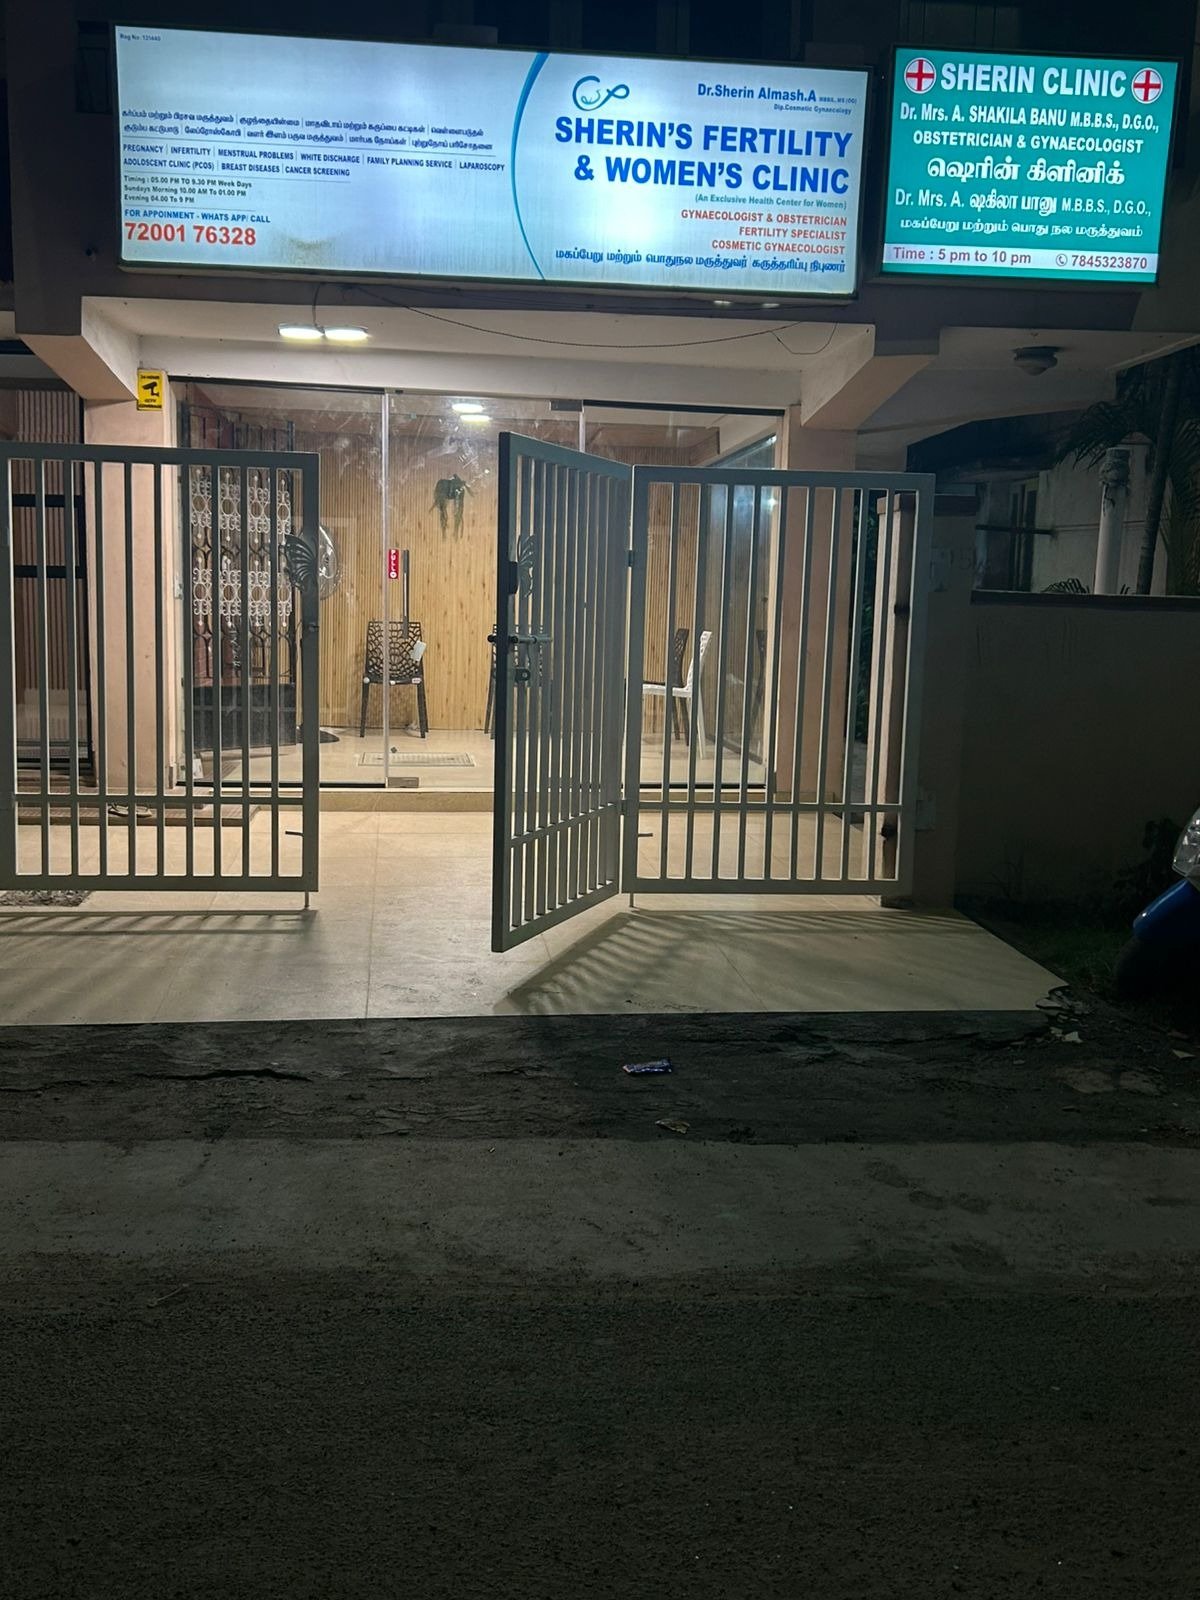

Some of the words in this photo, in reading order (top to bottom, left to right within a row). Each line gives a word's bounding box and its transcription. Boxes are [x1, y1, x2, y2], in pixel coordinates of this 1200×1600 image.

[941, 62, 1034, 94] SHERIN
[1043, 67, 1126, 98] CLINIC
[698, 84, 754, 98] Dr.Sherin
[758, 87, 816, 102] Almash.A
[900, 102, 916, 120] Dr.
[922, 103, 948, 121] Mrs.
[952, 105, 964, 122] A.
[970, 106, 1026, 125] SHAKILA
[1030, 108, 1066, 126] BANU
[1070, 112, 1118, 131] M.B.B.S.,
[1122, 114, 1159, 133] D.G.O.,
[555, 117, 692, 149] SHERIN'S
[703, 126, 852, 157] FERTILITY
[914, 130, 1012, 147] OBSTETRICIAN
[1016, 135, 1026, 148] &
[1031, 137, 1143, 153] GYNAECOLOGIST
[123, 144, 163, 153] PREGNANCY
[171, 146, 211, 156] INFERTILITY
[218, 149, 257, 158] MENSTRUAL
[259, 151, 294, 160] PROBLEMS
[301, 153, 321, 161] WHITE
[323, 154, 360, 163] DISCHARGE
[367, 156, 389, 165] FAMILY
[392, 158, 424, 167] PLANNING
[426, 160, 452, 168] SERVICE
[460, 162, 505, 171] LAPAROSCOPY
[169, 160, 190, 168] CLINIC
[193, 162, 214, 171] (PCOS)
[221, 163, 246, 171] BREAST
[249, 164, 280, 173] DISEASES
[285, 166, 312, 174] CANCER
[313, 167, 350, 176] SCREENING
[574, 154, 594, 180] &
[606, 157, 742, 188] WOMEN'S
[753, 164, 849, 193] CLINIC
[928, 156, 1020, 182] ஷெரின்
[1027, 158, 1126, 184] கிளினிக்
[696, 194, 708, 203] (An
[710, 194, 746, 204] Exclusive
[749, 196, 774, 205] Health
[776, 198, 802, 206] Center
[804, 199, 814, 207] for
[816, 200, 847, 210] Women)
[895, 188, 913, 206] Dr.
[918, 189, 947, 207] Mrs.
[951, 191, 964, 207] A.
[970, 189, 1018, 212] ஷகிலா
[1021, 193, 1056, 216] பானு
[1062, 199, 1110, 215] M.B.B.S.,
[1113, 200, 1151, 216] D.G.O.,
[125, 209, 140, 217] FOR
[143, 210, 195, 219] APPOINMENT
[201, 213, 229, 221] WHATS
[250, 215, 270, 223] CALL
[682, 209, 763, 222] GYNAECOLOGIST
[766, 214, 773, 222] &
[777, 214, 847, 226] OBSTETRICIAN
[900, 216, 959, 232] மகப்பேறு
[962, 219, 1008, 234] மற்றும்
[1011, 223, 1048, 236] பொது
[1051, 225, 1073, 236] நல
[1076, 223, 1142, 239] மருத்துவம்
[125, 223, 185, 242] 72001
[193, 225, 256, 246] 76328
[739, 226, 788, 238] FERTILITY
[791, 229, 846, 240] SPECIALIST
[712, 240, 761, 250] COSMETIC
[764, 242, 845, 254] GYNAECOLOGIST
[894, 247, 925, 260] Time
[938, 248, 946, 261] 5
[949, 252, 970, 264] pm
[975, 251, 987, 262] to
[992, 251, 1006, 263] 10
[1011, 254, 1031, 266] pm
[1071, 255, 1148, 269] 7845323870
[556, 247, 603, 263] மகப்பேறு
[607, 249, 642, 264] மற்றும்
[696, 254, 748, 268] மருத்துவர்
[752, 256, 807, 272] கருத்தரிப்பு
[810, 260, 845, 273] நிபுணர்
